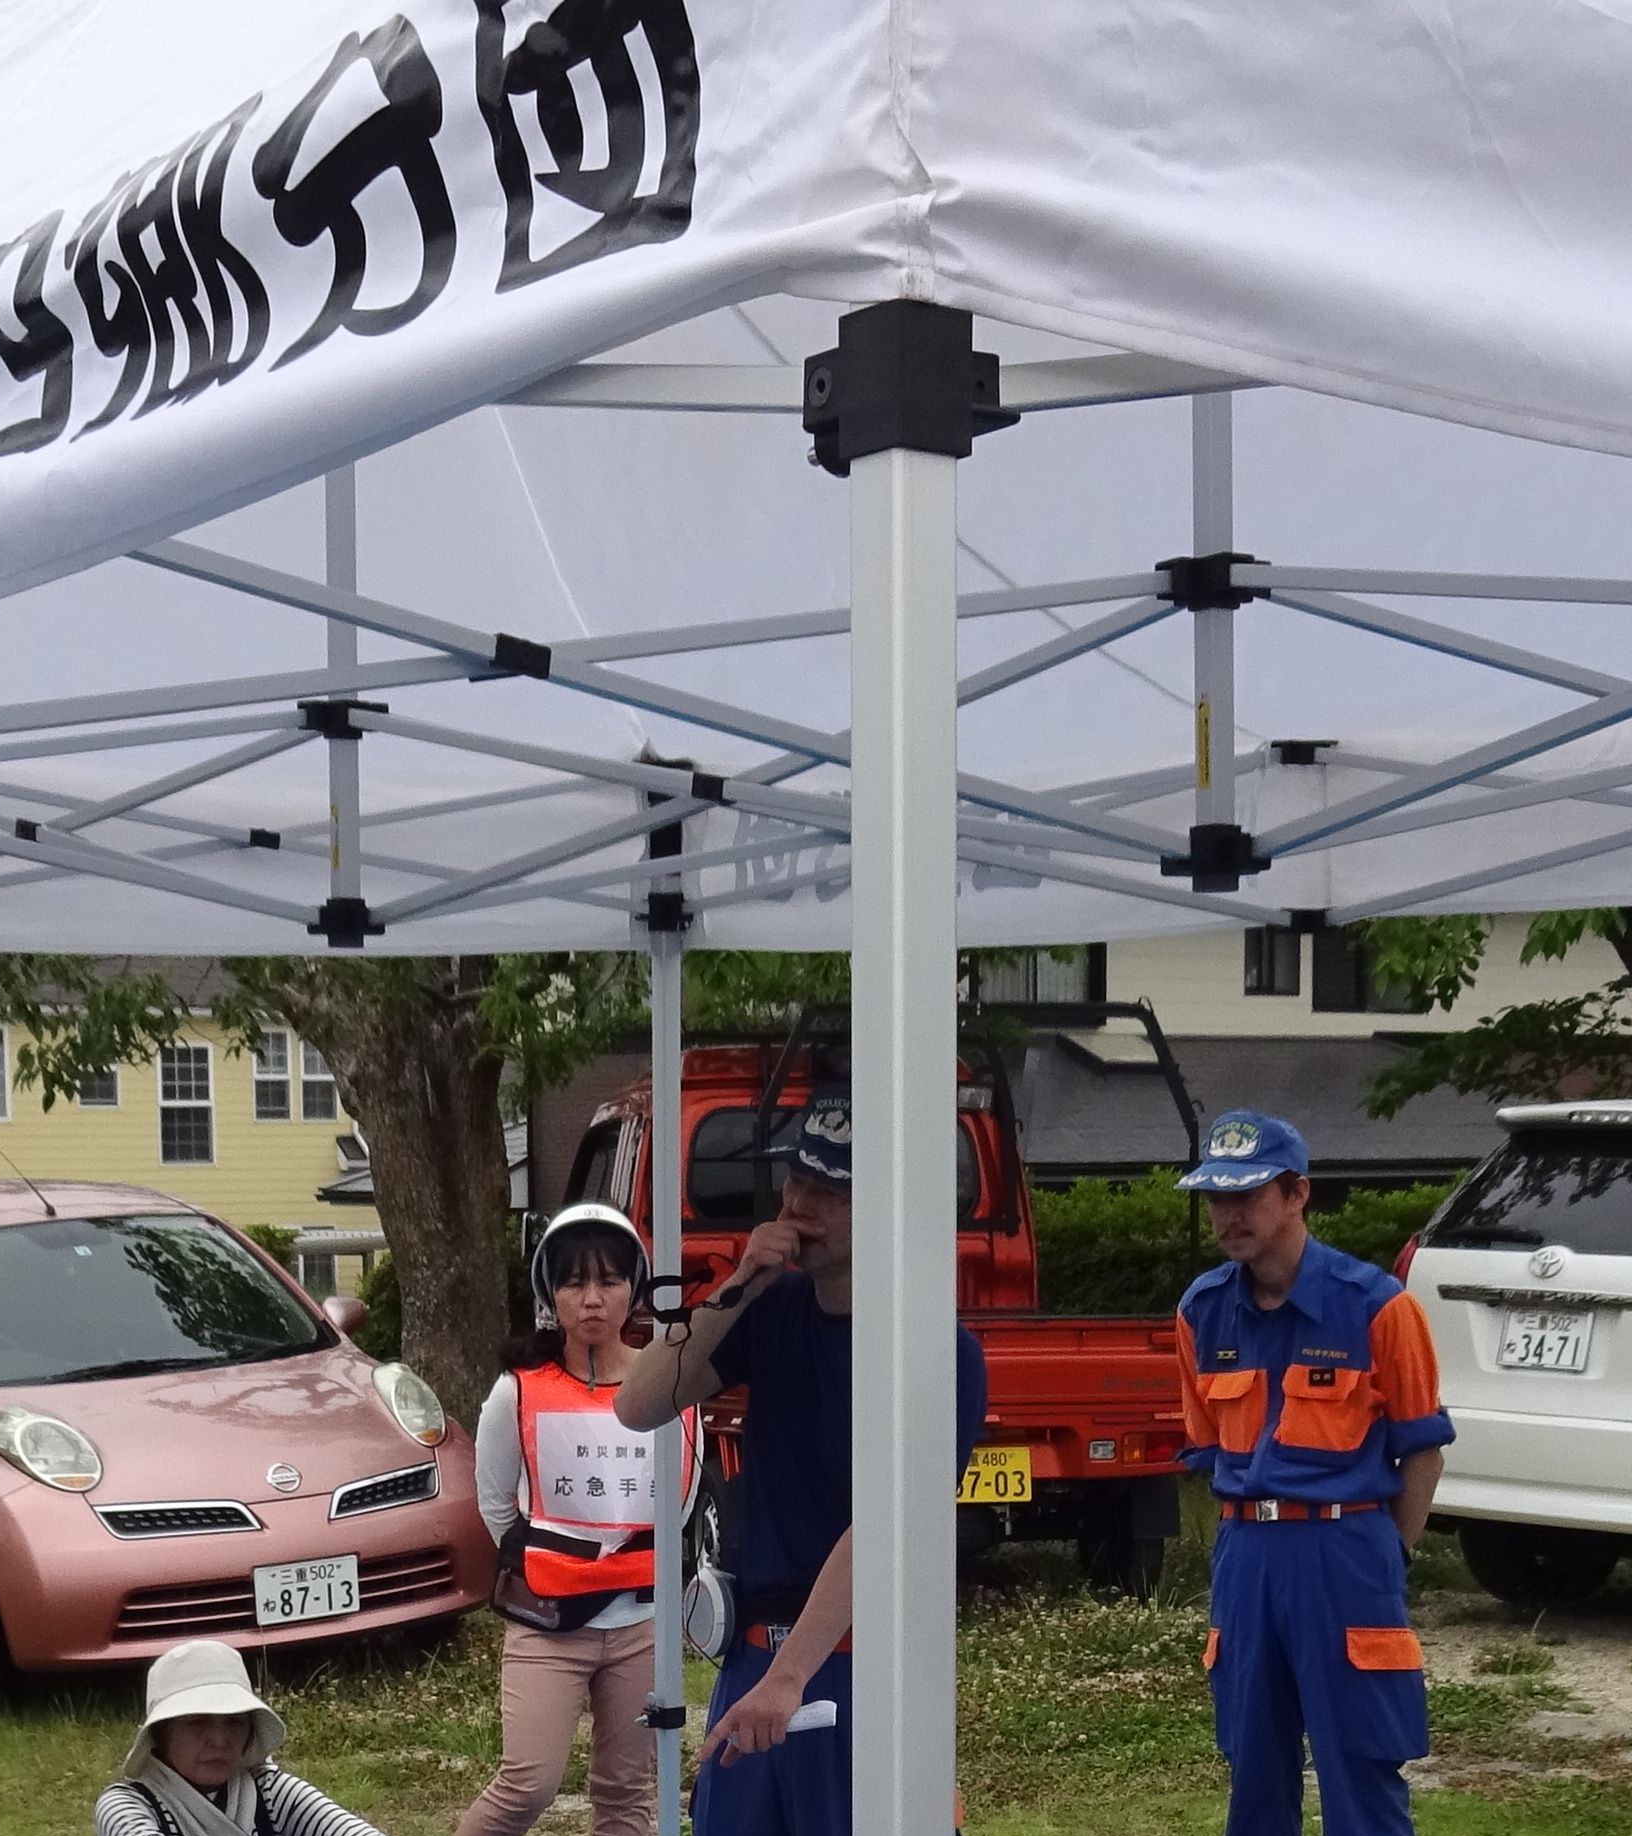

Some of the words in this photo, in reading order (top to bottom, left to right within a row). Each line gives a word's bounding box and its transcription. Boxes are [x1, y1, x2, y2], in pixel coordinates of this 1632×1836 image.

[1519, 1333, 1581, 1365] 34-71
[554, 1475, 655, 1498] 応急手
[280, 1580, 354, 1617] 87-13
